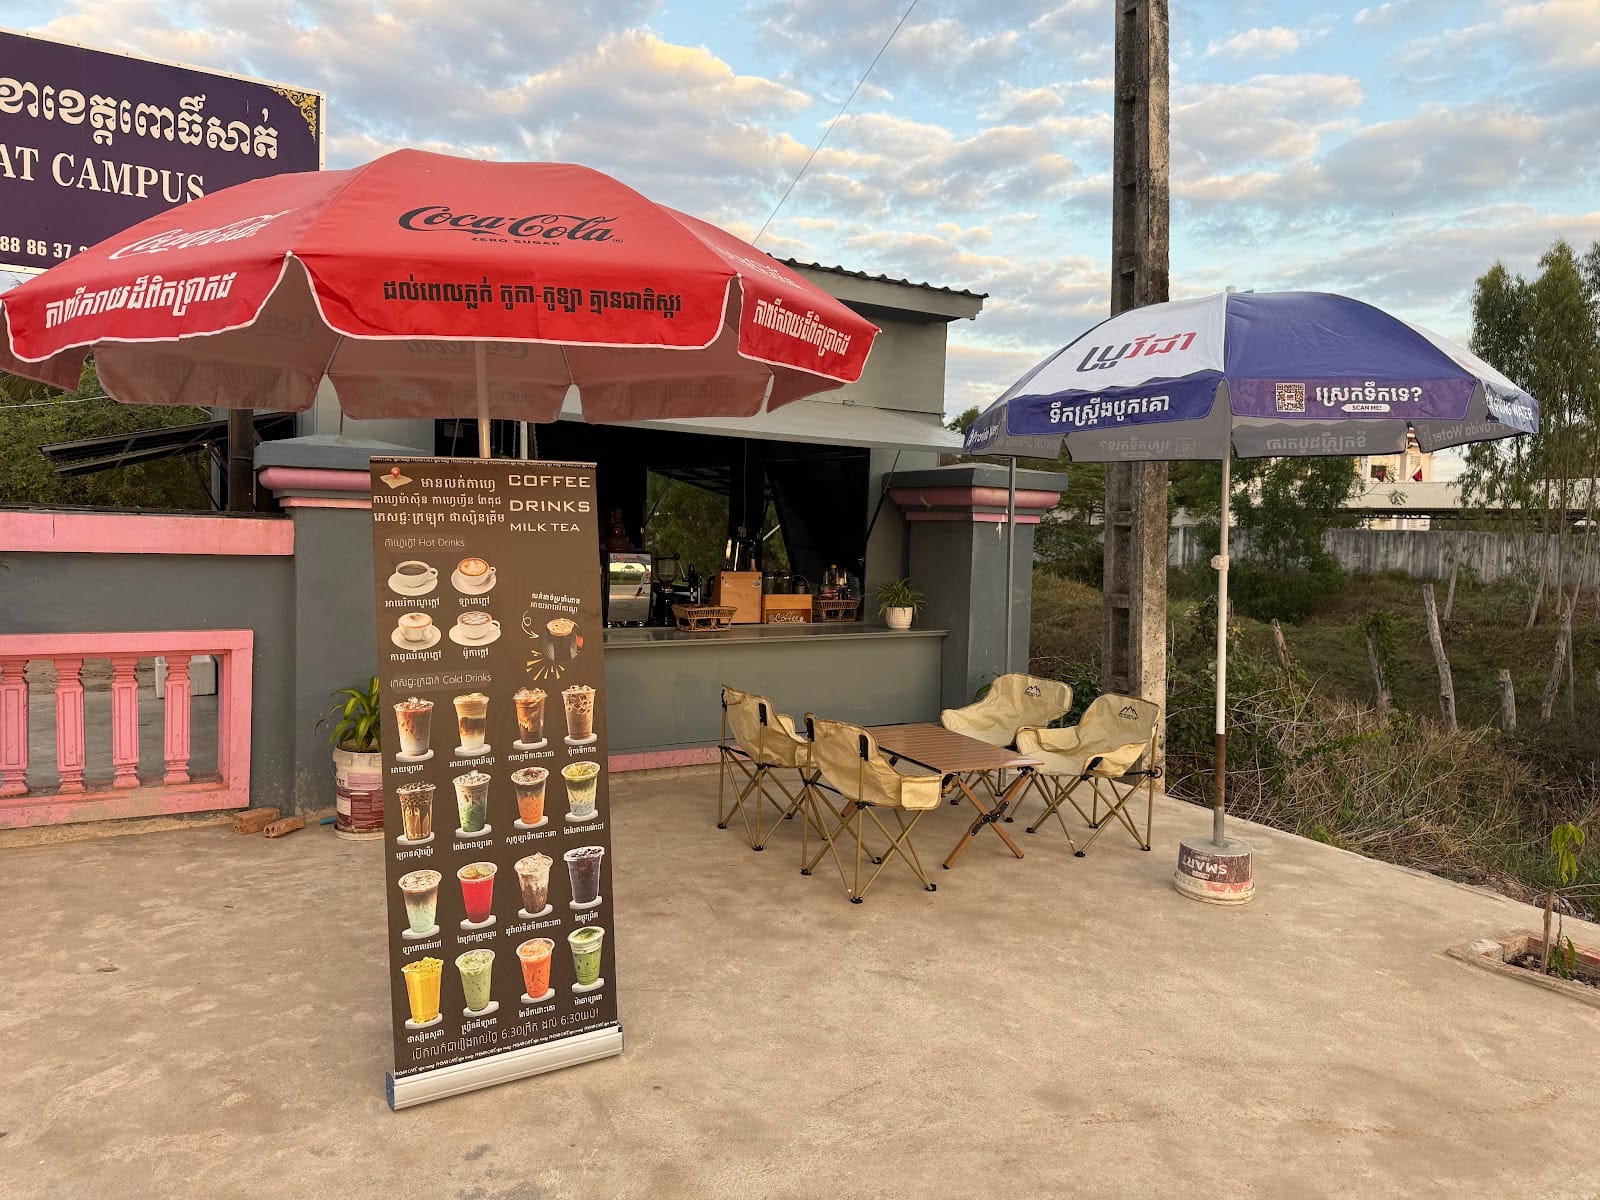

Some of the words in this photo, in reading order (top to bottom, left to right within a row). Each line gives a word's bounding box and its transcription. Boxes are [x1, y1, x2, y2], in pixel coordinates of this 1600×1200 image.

[52, 152, 206, 203] CAMPUS
[398, 205, 618, 242] Coca-Cola
[471, 236, 508, 244] ZERO
[513, 238, 560, 246] SUGAR
[26, 239, 47, 256] 86
[53, 242, 72, 259] 37
[508, 474, 591, 488] COFFEE
[509, 500, 590, 513] DRINKS
[510, 523, 547, 532] MILK
[550, 524, 581, 533] TEA
[418, 538, 436, 547] Hot
[437, 538, 465, 547] Drinks
[442, 675, 463, 684] Cold
[465, 673, 492, 683] Drinks
[1182, 855, 1228, 875] SMART
